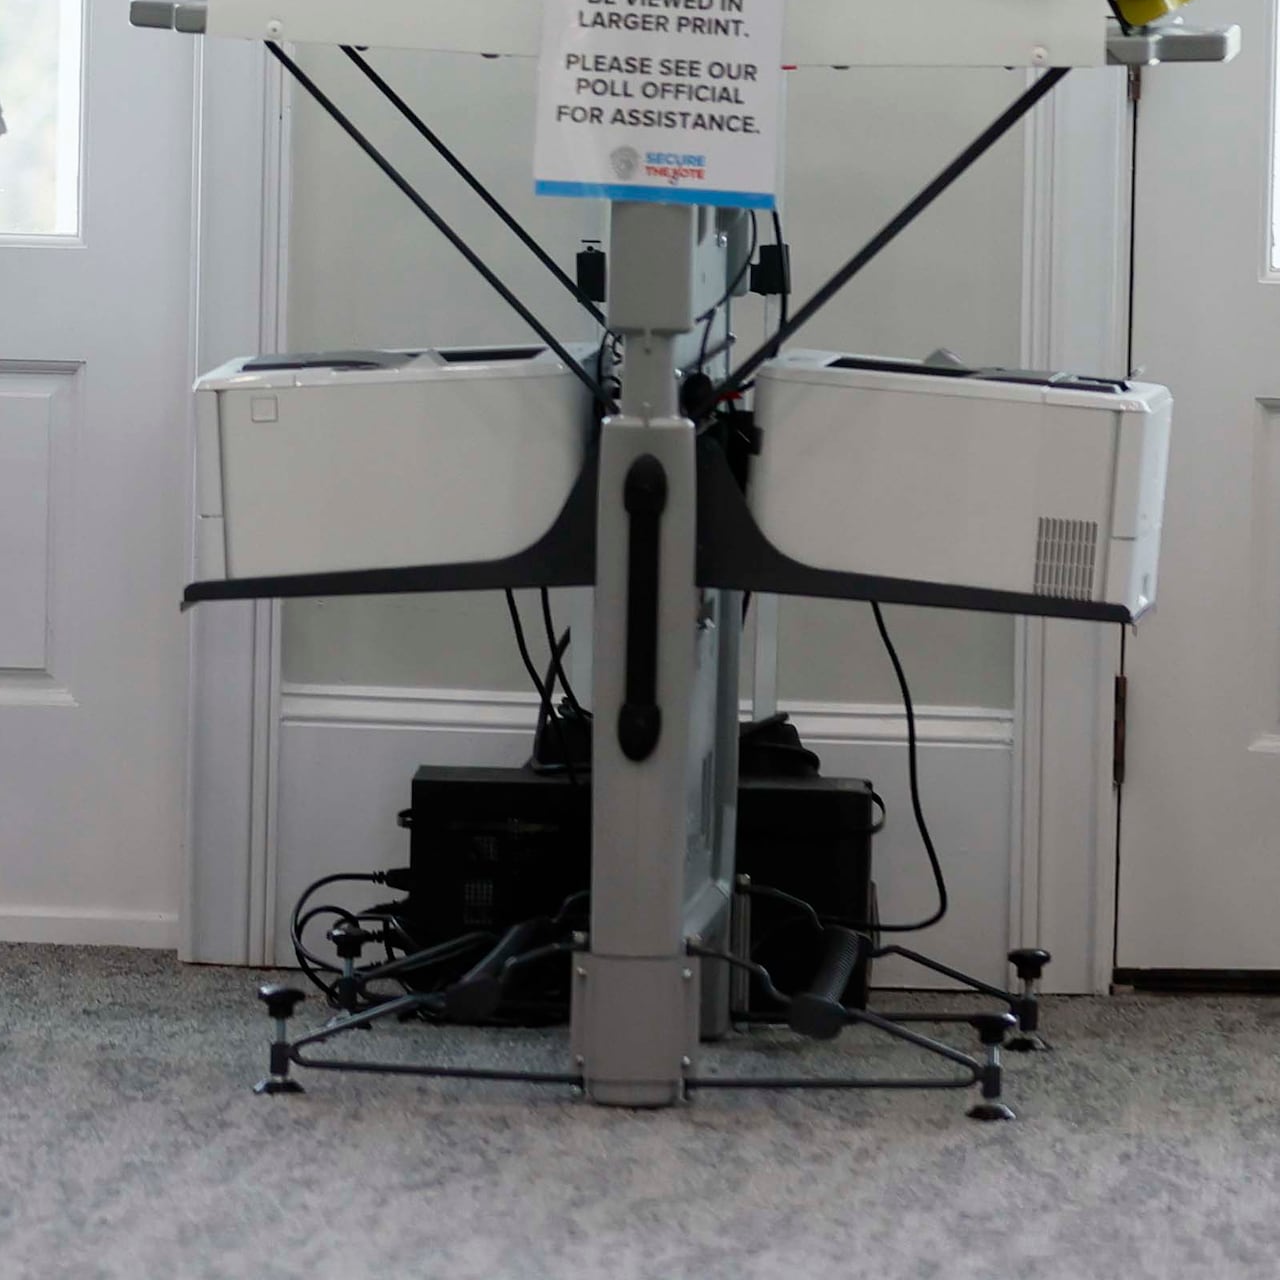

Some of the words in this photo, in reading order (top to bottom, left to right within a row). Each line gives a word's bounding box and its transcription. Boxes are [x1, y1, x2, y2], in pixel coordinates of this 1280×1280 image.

[578, 10, 669, 32] LARGER
[677, 15, 750, 37] PRINT.
[565, 53, 652, 75] PLEASE
[659, 58, 702, 78] SEE
[708, 61, 758, 82] OUR
[576, 77, 634, 98] POLL
[641, 81, 745, 105] OFFICIAL
[556, 105, 604, 124] FOR
[610, 108, 760, 135] ASSISTANCE.
[645, 152, 706, 167] SECURE
